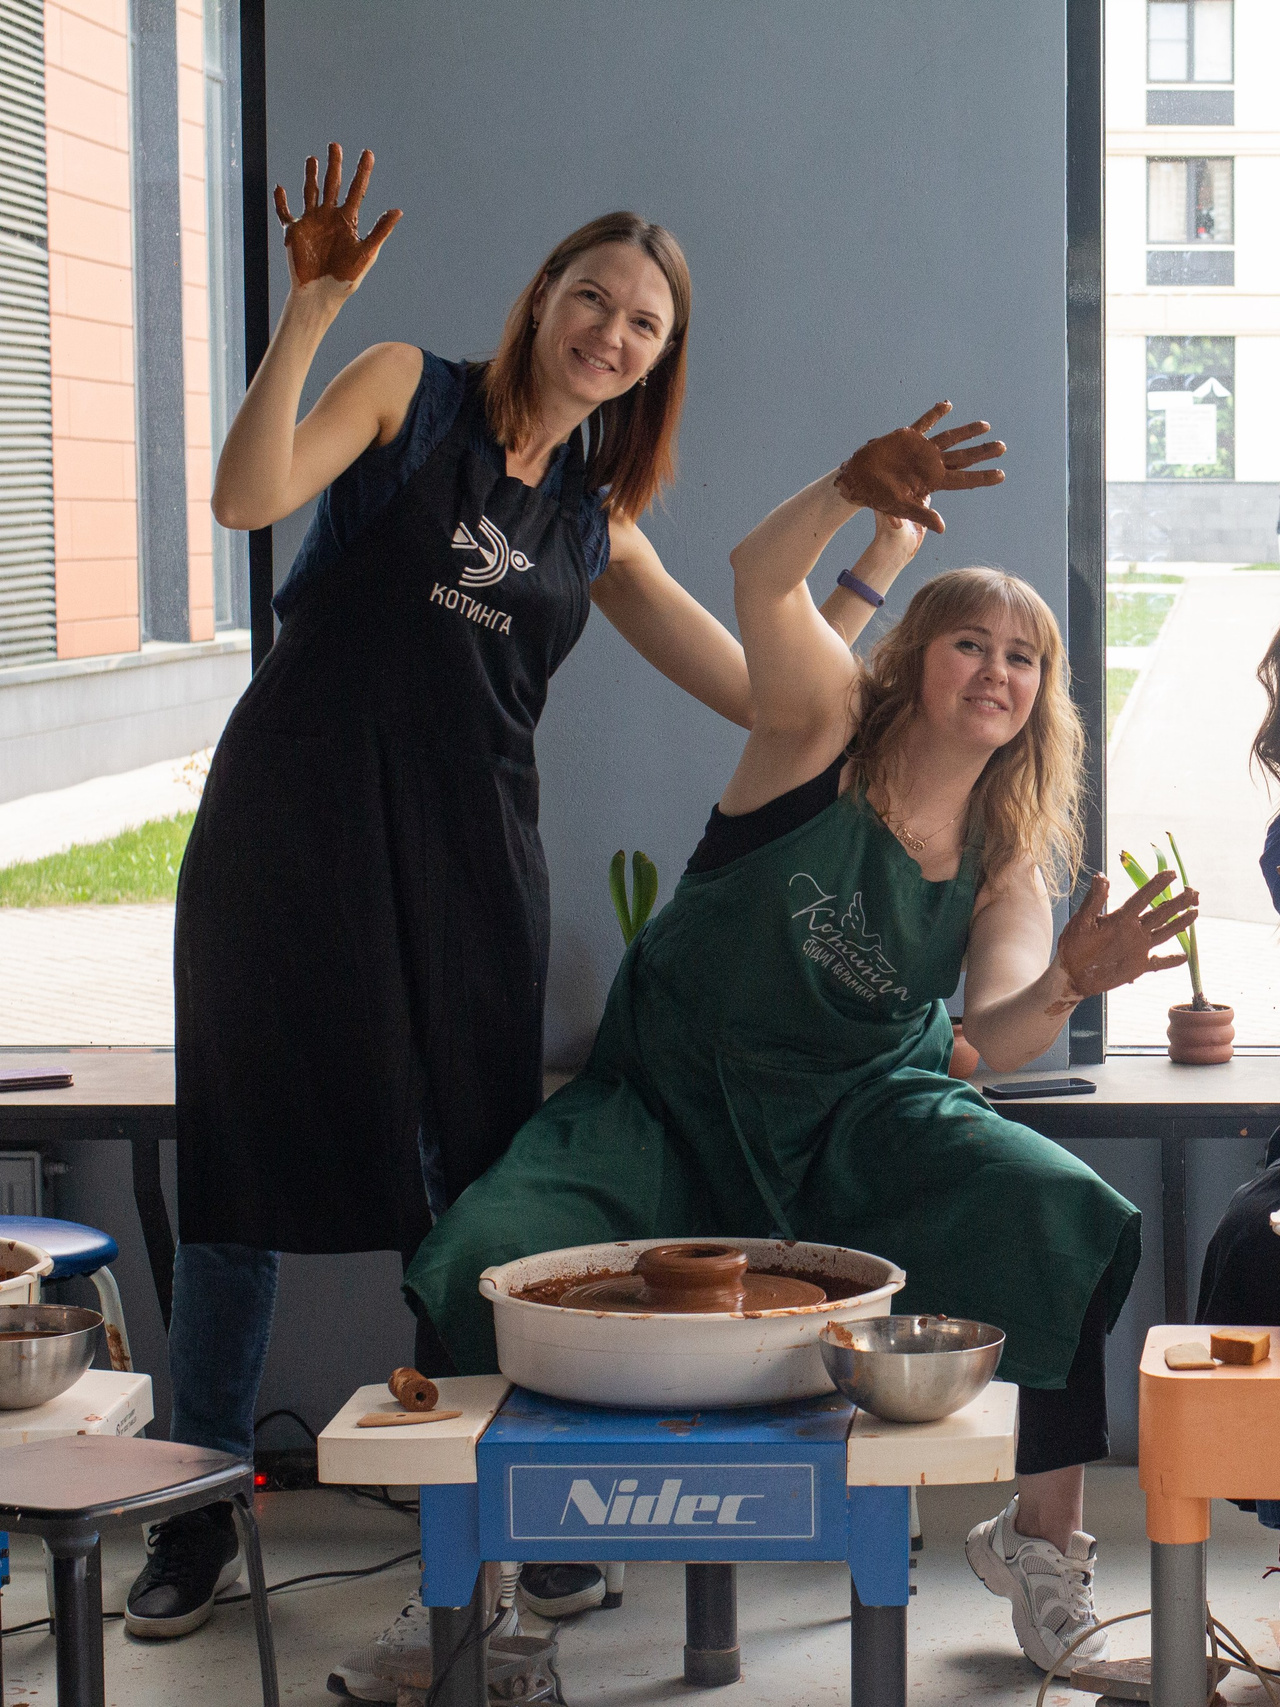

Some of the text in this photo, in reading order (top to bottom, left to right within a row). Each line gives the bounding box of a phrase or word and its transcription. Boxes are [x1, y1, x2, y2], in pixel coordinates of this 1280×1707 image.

[429, 582, 513, 635] КОТИНГА
[802, 939, 877, 1002] СТУДИЯ КЕРАМИКИ
[560, 1479, 765, 1525] Nidec
